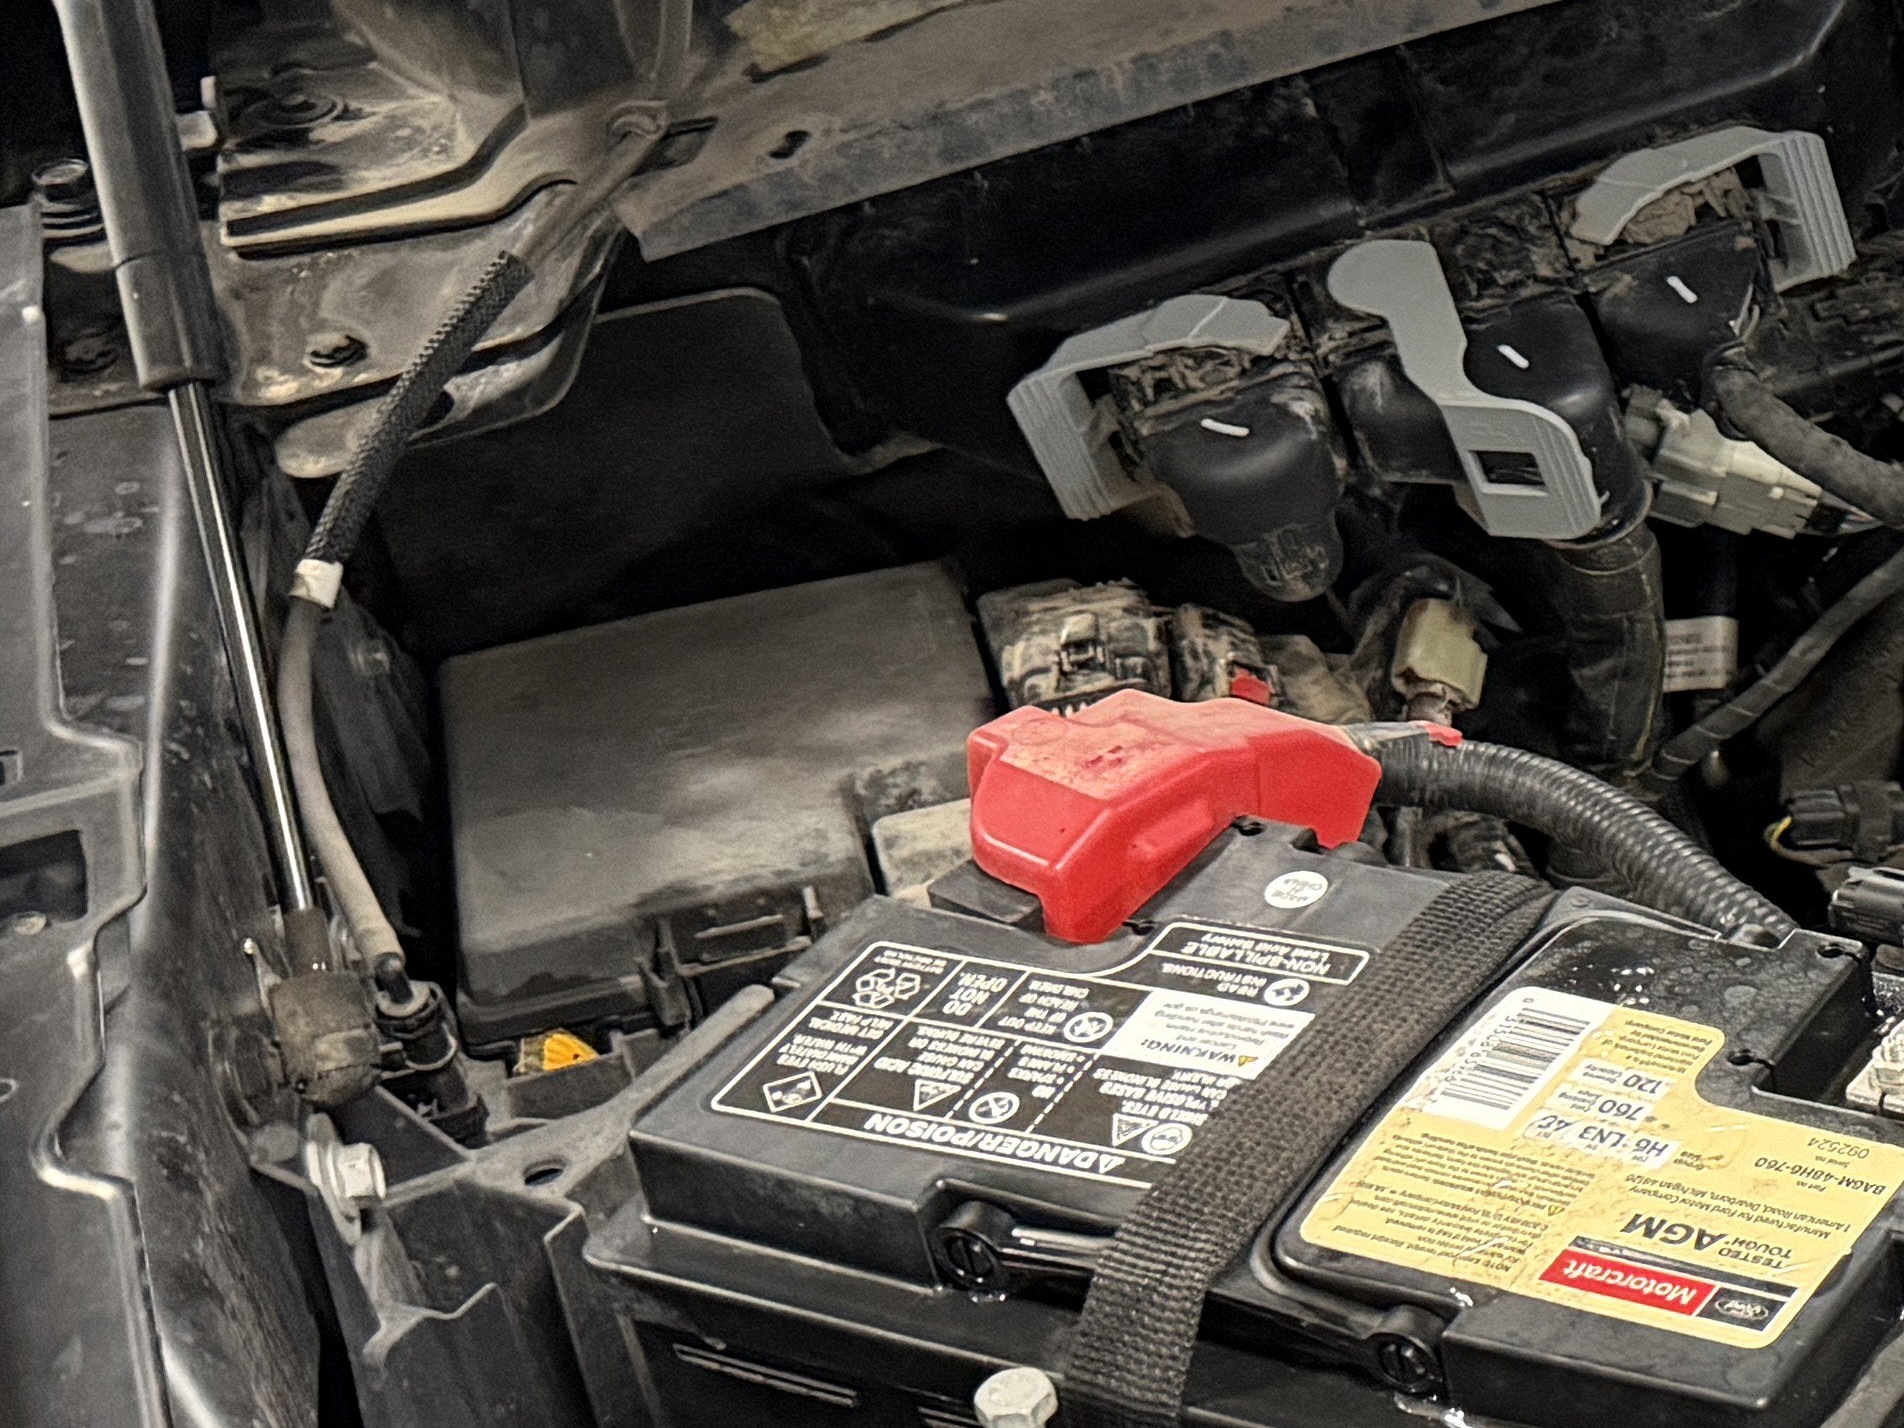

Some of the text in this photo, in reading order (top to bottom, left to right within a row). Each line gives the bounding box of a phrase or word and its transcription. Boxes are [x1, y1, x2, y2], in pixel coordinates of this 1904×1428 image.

[1178, 941, 1331, 974] NON-SPILLABLE
[945, 986, 993, 1004] NOT
[937, 999, 975, 1016] DO
[1137, 1038, 1238, 1062] WARNING:
[870, 1056, 912, 1072] ACID
[953, 1057, 987, 1071] CAN
[1619, 1073, 1665, 1094] 120
[1594, 1098, 1646, 1120] 760
[861, 1112, 1102, 1169] DANGER/POISON
[1575, 1125, 1627, 1147] LN3
[1629, 1137, 1669, 1157] H6
[1805, 1136, 1872, 1159] 092524
[1626, 1184, 1832, 1239] Manufactured for Ford Motor Company
[1618, 1212, 1728, 1253] AGM
[1716, 1246, 1786, 1269] TESTED
[1557, 1259, 1699, 1305] Motorcraft
